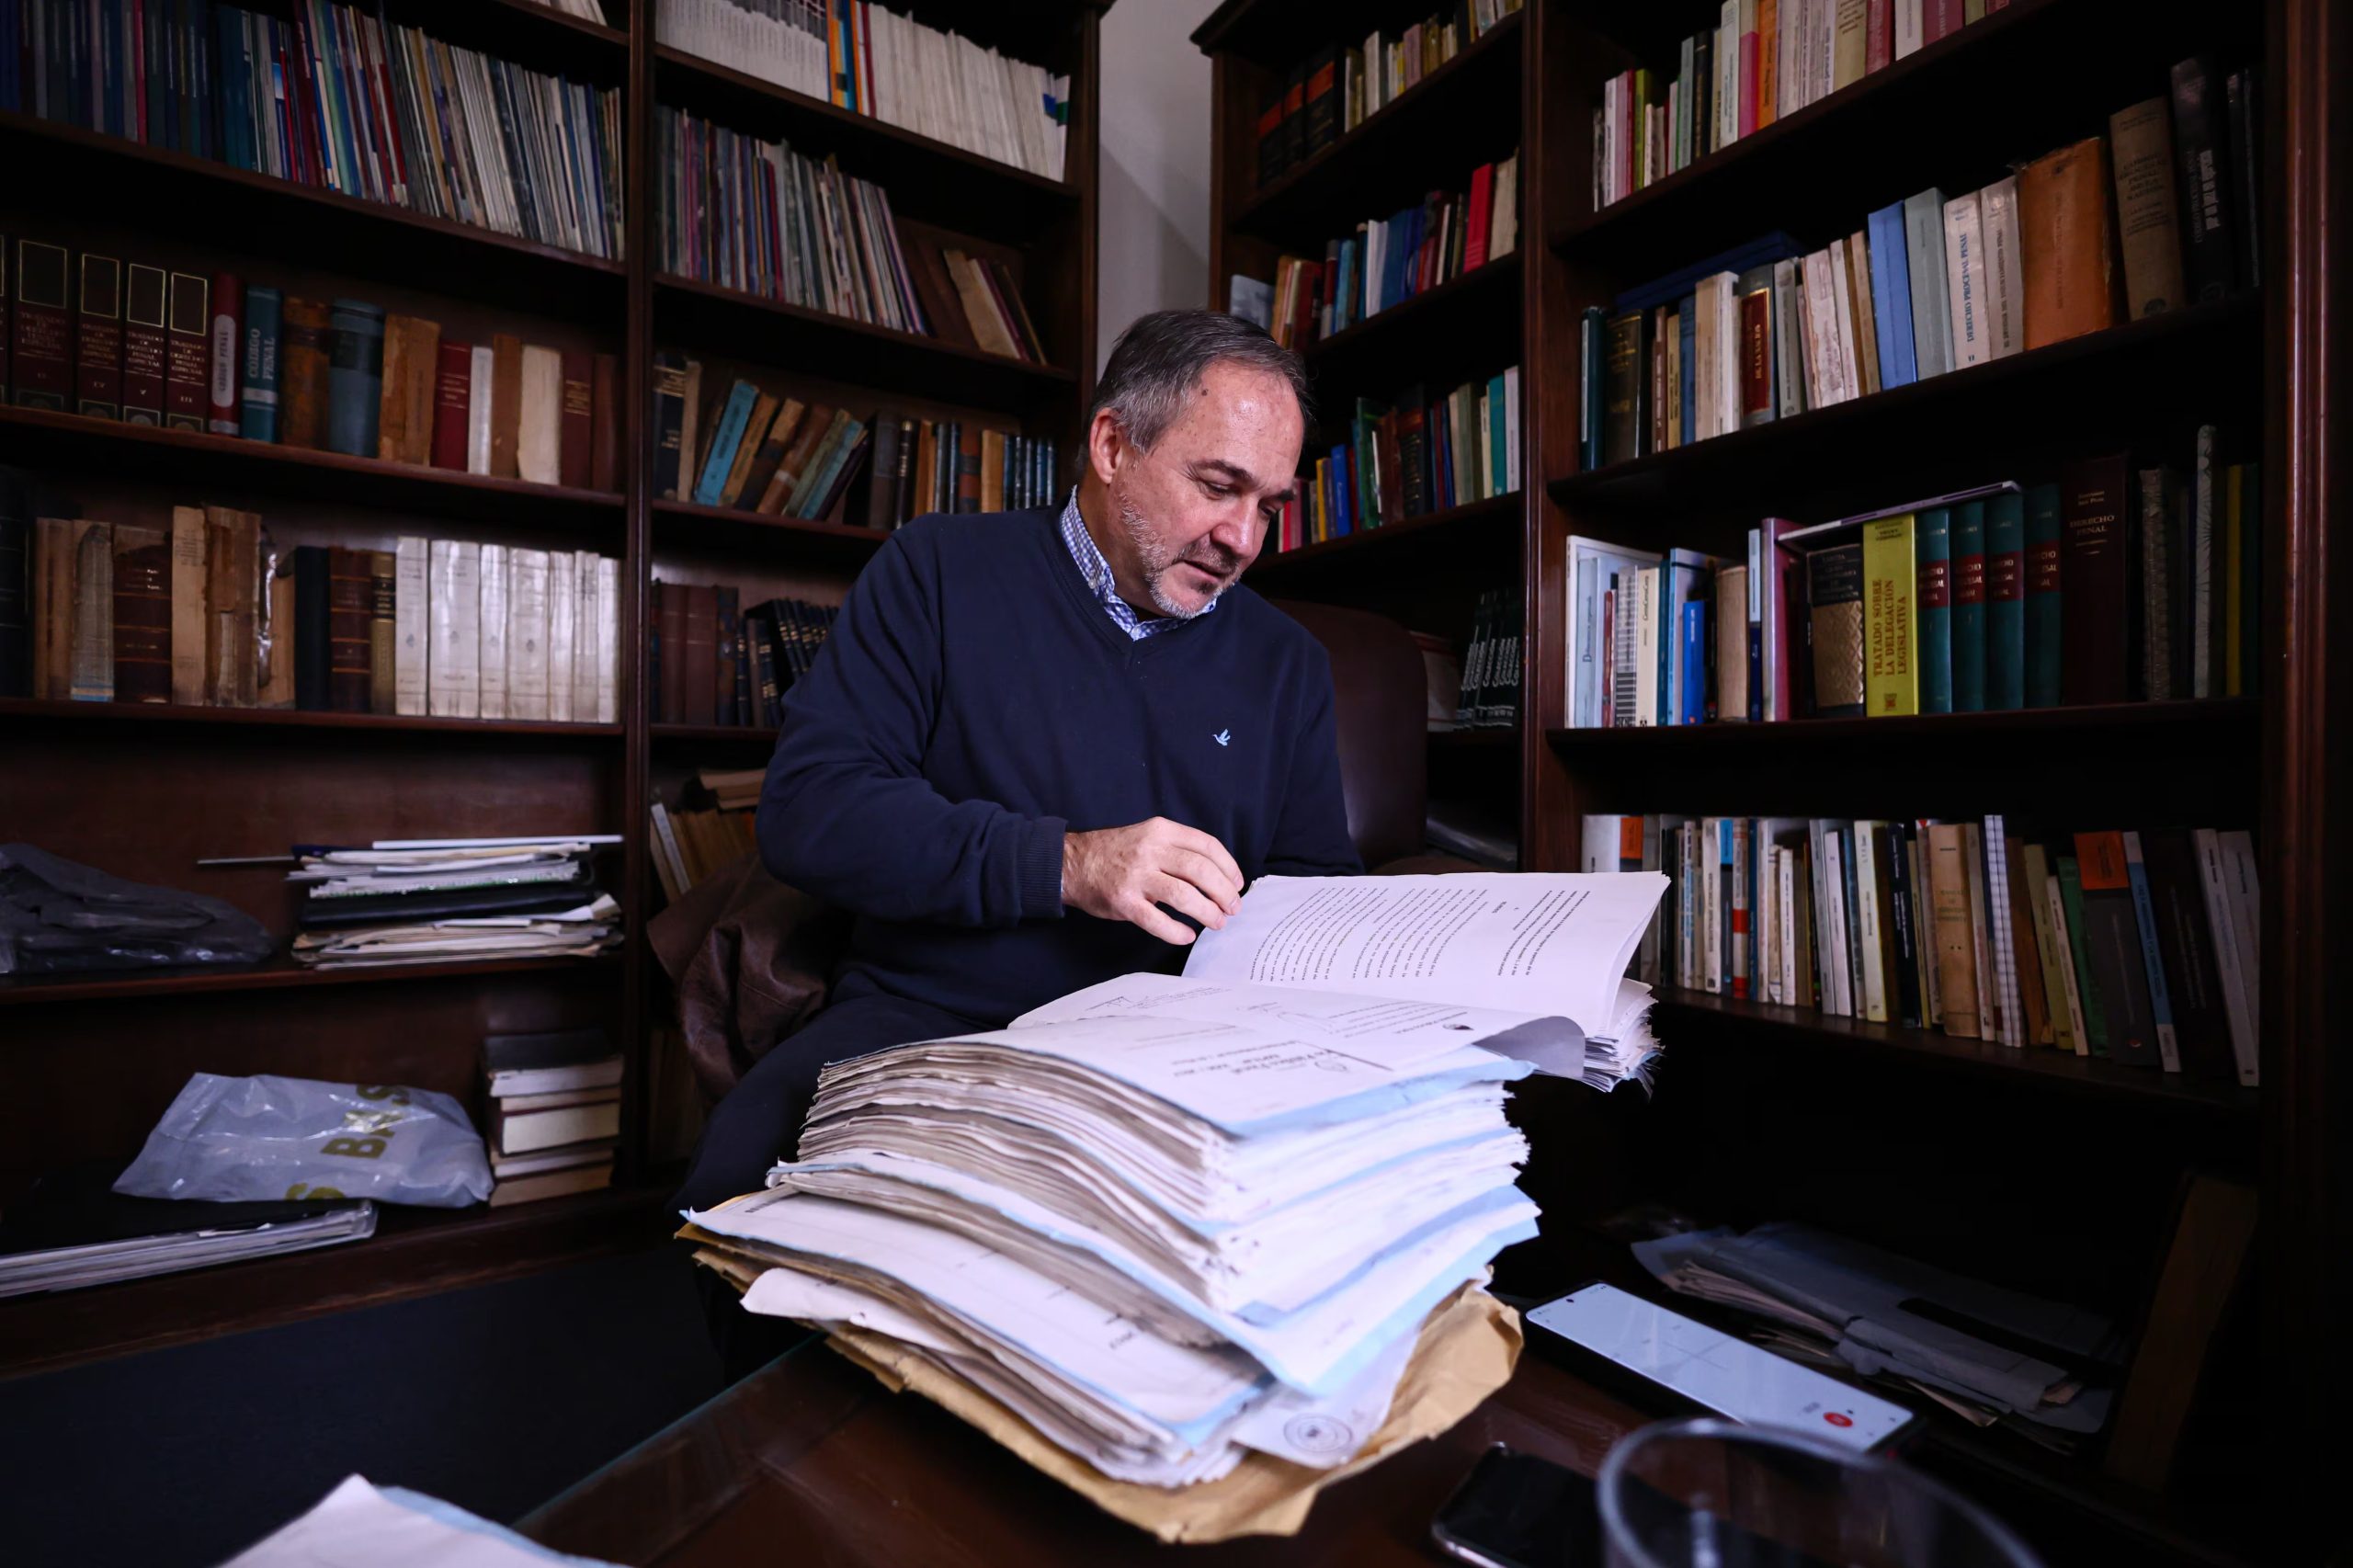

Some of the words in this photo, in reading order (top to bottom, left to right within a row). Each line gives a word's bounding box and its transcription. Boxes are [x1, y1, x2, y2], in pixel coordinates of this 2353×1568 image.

[1959, 233, 1969, 257] PENAL
[1960, 259, 1972, 301] PROCESAL
[1962, 302, 1975, 342] DERECHO
[262, 337, 276, 381] PENAL
[2069, 515, 2115, 528] DERECHO
[2076, 525, 2108, 536] PENAL
[1871, 579, 1882, 619] SOBRE
[1872, 623, 1882, 677] TRATADO
[1896, 596, 1907, 675] LEGISLATIVA
[1885, 661, 1895, 676] LA
